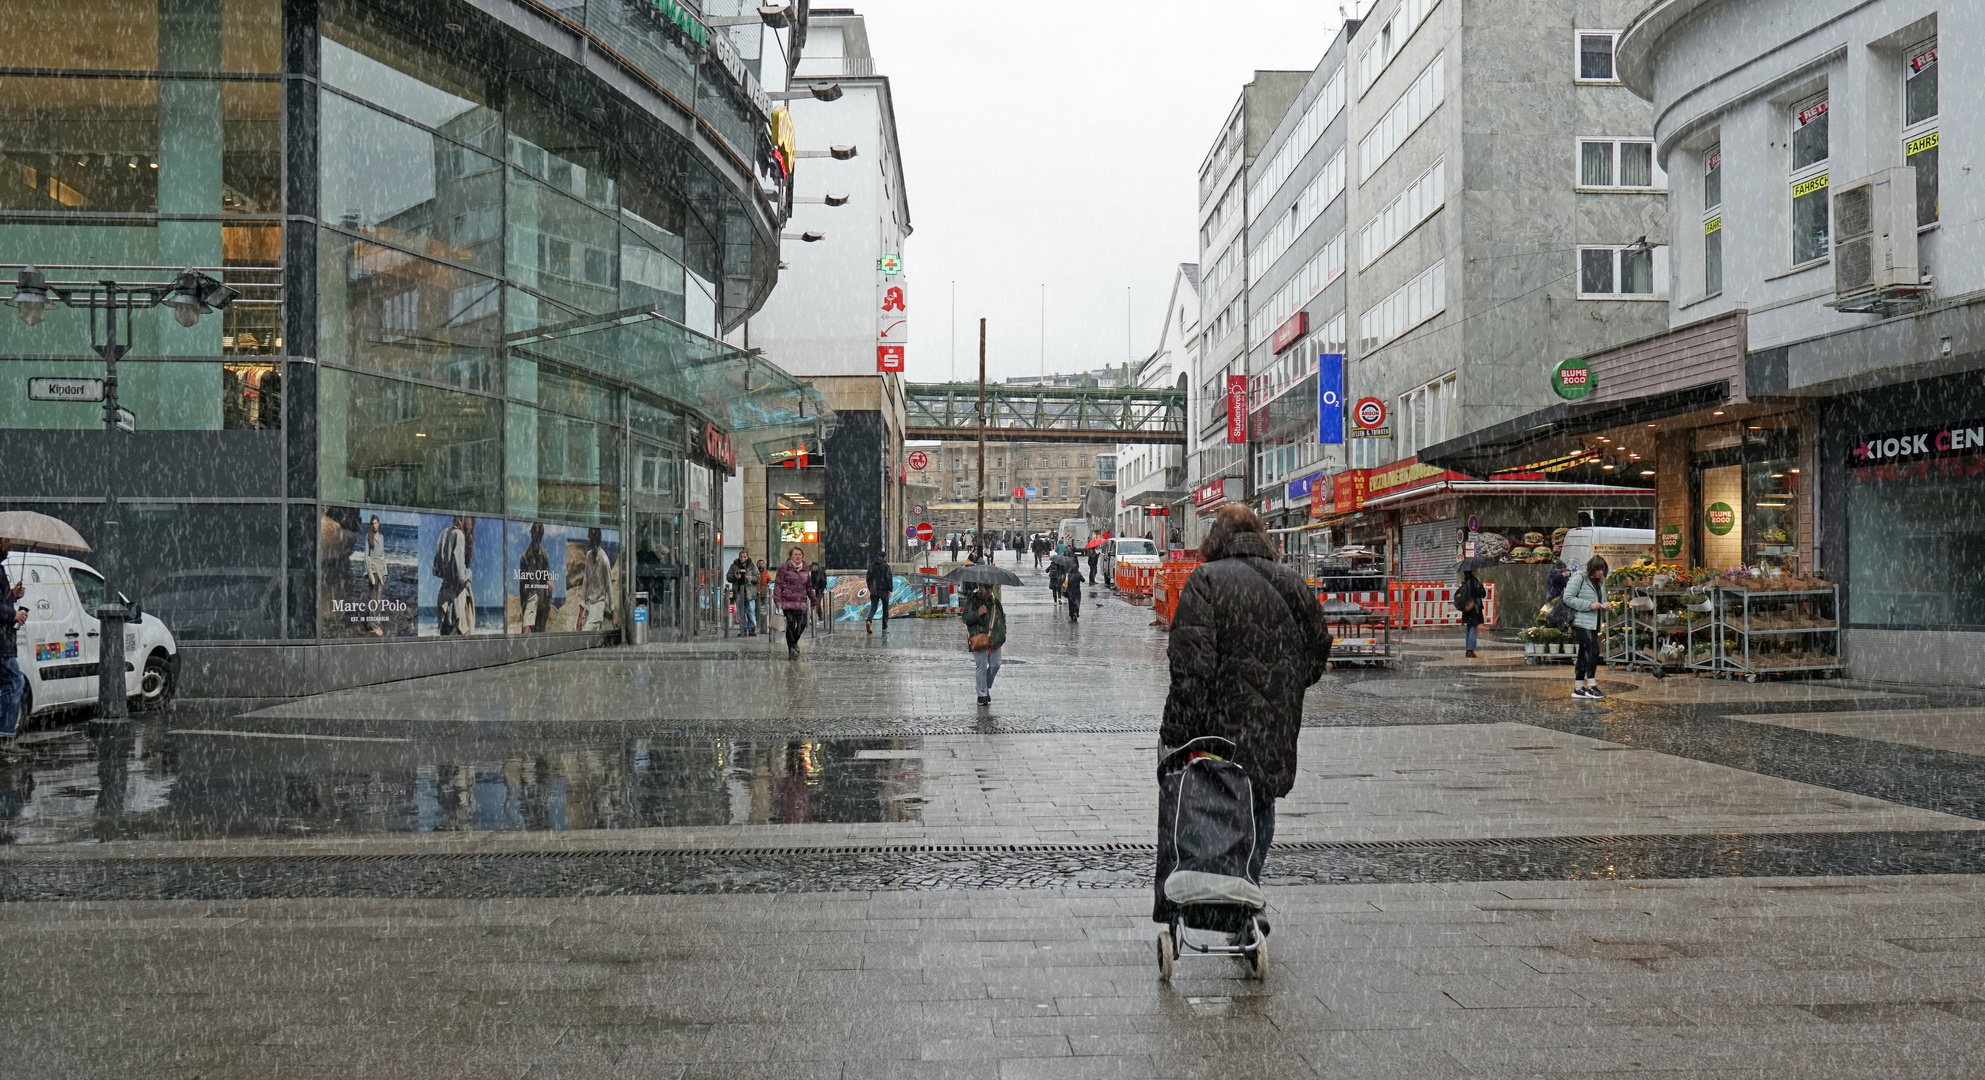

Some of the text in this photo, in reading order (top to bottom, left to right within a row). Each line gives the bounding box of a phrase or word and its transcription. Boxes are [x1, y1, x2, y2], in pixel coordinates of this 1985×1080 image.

[716, 33, 746, 87] GERRY
[1917, 50, 1938, 67] RE
[1908, 135, 1939, 155] FAHRS
[1561, 369, 1587, 377] BLUME
[49, 384, 85, 396] Kipdorf
[1866, 426, 1984, 460] KIOSK CEN
[1354, 470, 1364, 508] IMBISS
[1369, 472, 1388, 493] PIZZA
[513, 569, 559, 580] Marc O'Polo
[332, 599, 407, 612] Marc O'Polo
